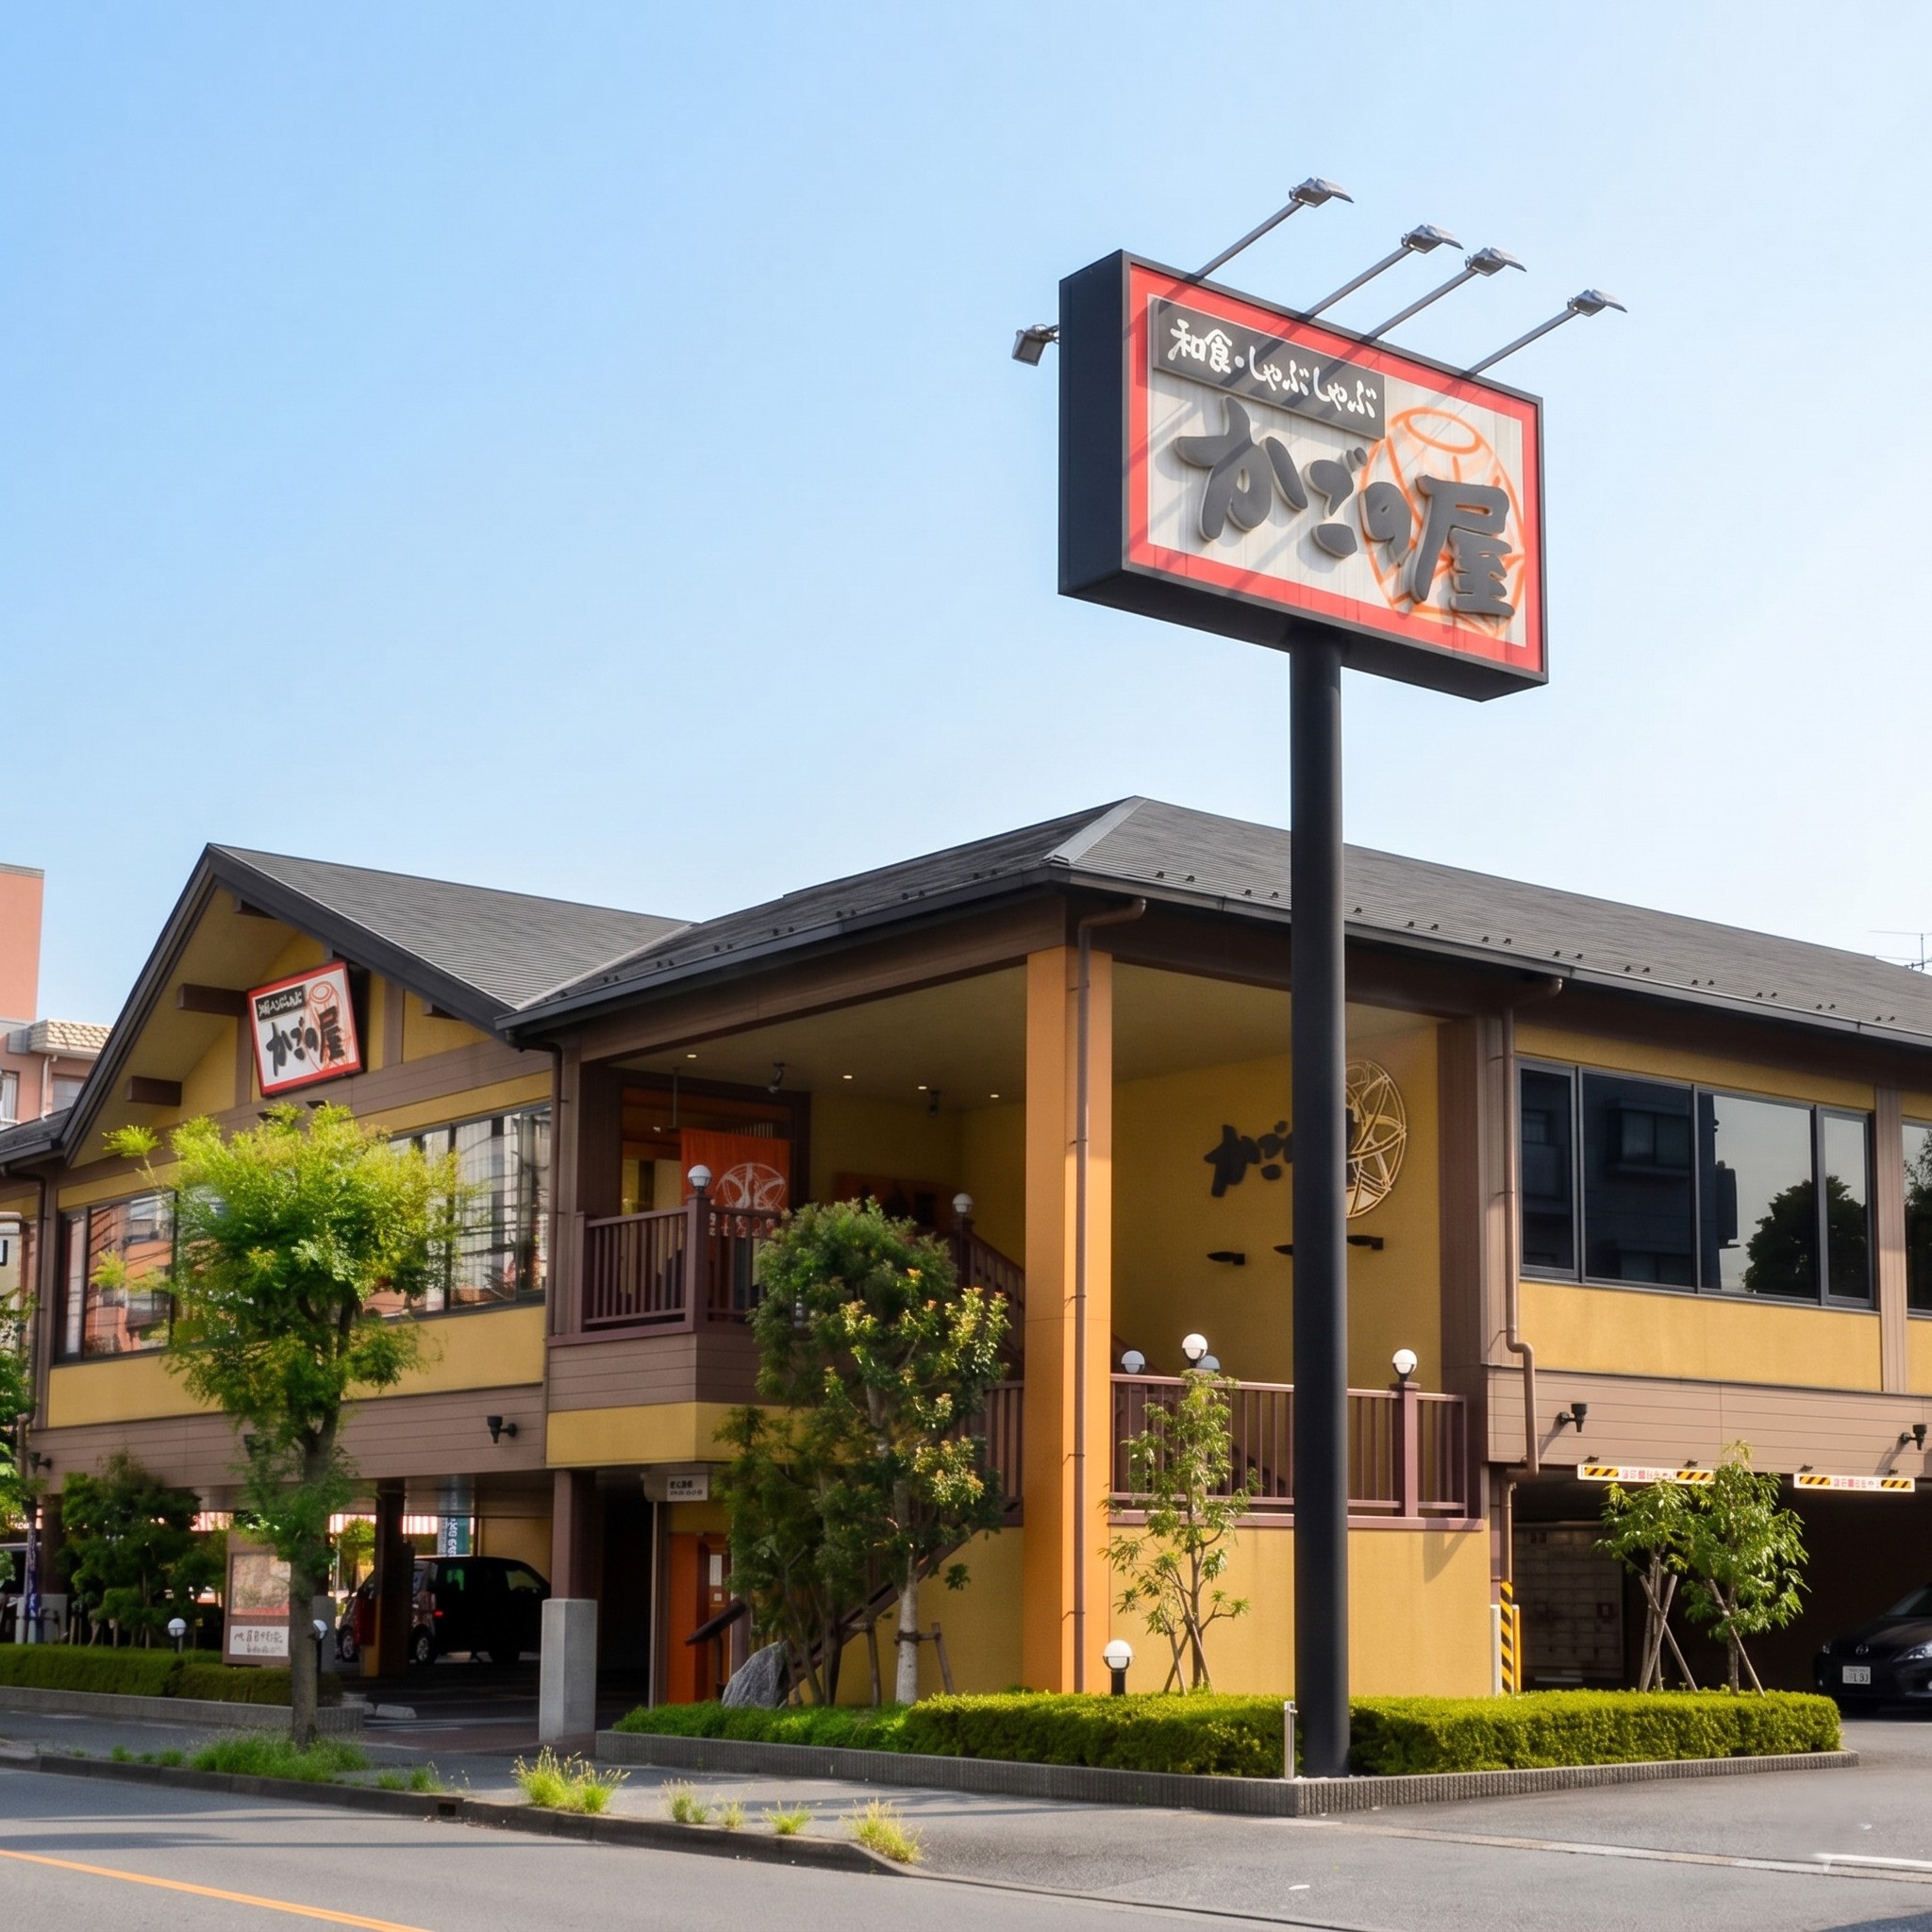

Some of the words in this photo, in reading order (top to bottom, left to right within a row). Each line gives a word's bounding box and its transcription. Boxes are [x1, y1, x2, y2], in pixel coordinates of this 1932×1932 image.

[1167, 318, 1377, 419] 和食・しゃぶしゃぶ
[1173, 395, 1516, 618] かごの屋
[265, 1005, 345, 1076] かごの屋
